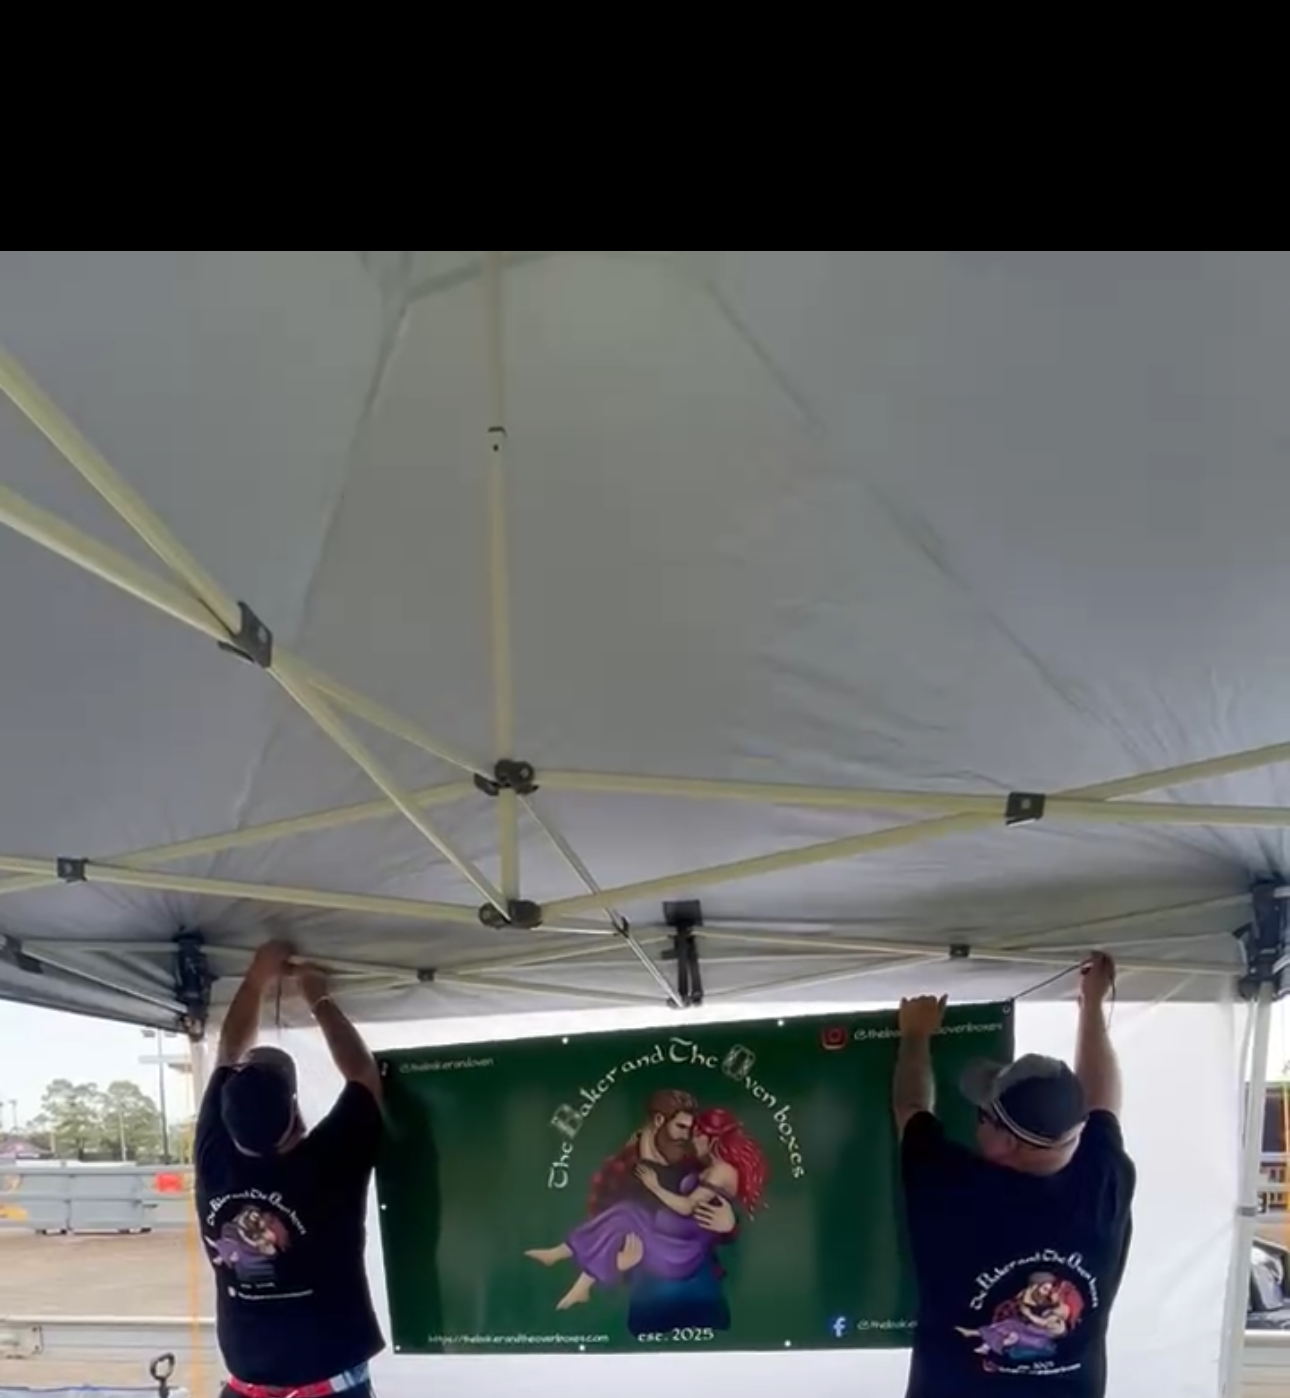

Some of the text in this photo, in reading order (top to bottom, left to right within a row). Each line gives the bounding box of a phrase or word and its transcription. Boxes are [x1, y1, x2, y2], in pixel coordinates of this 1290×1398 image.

[548, 1037, 804, 1188] The Baker and The Oven boxes
[638, 1327, 714, 1343] est. 2025
